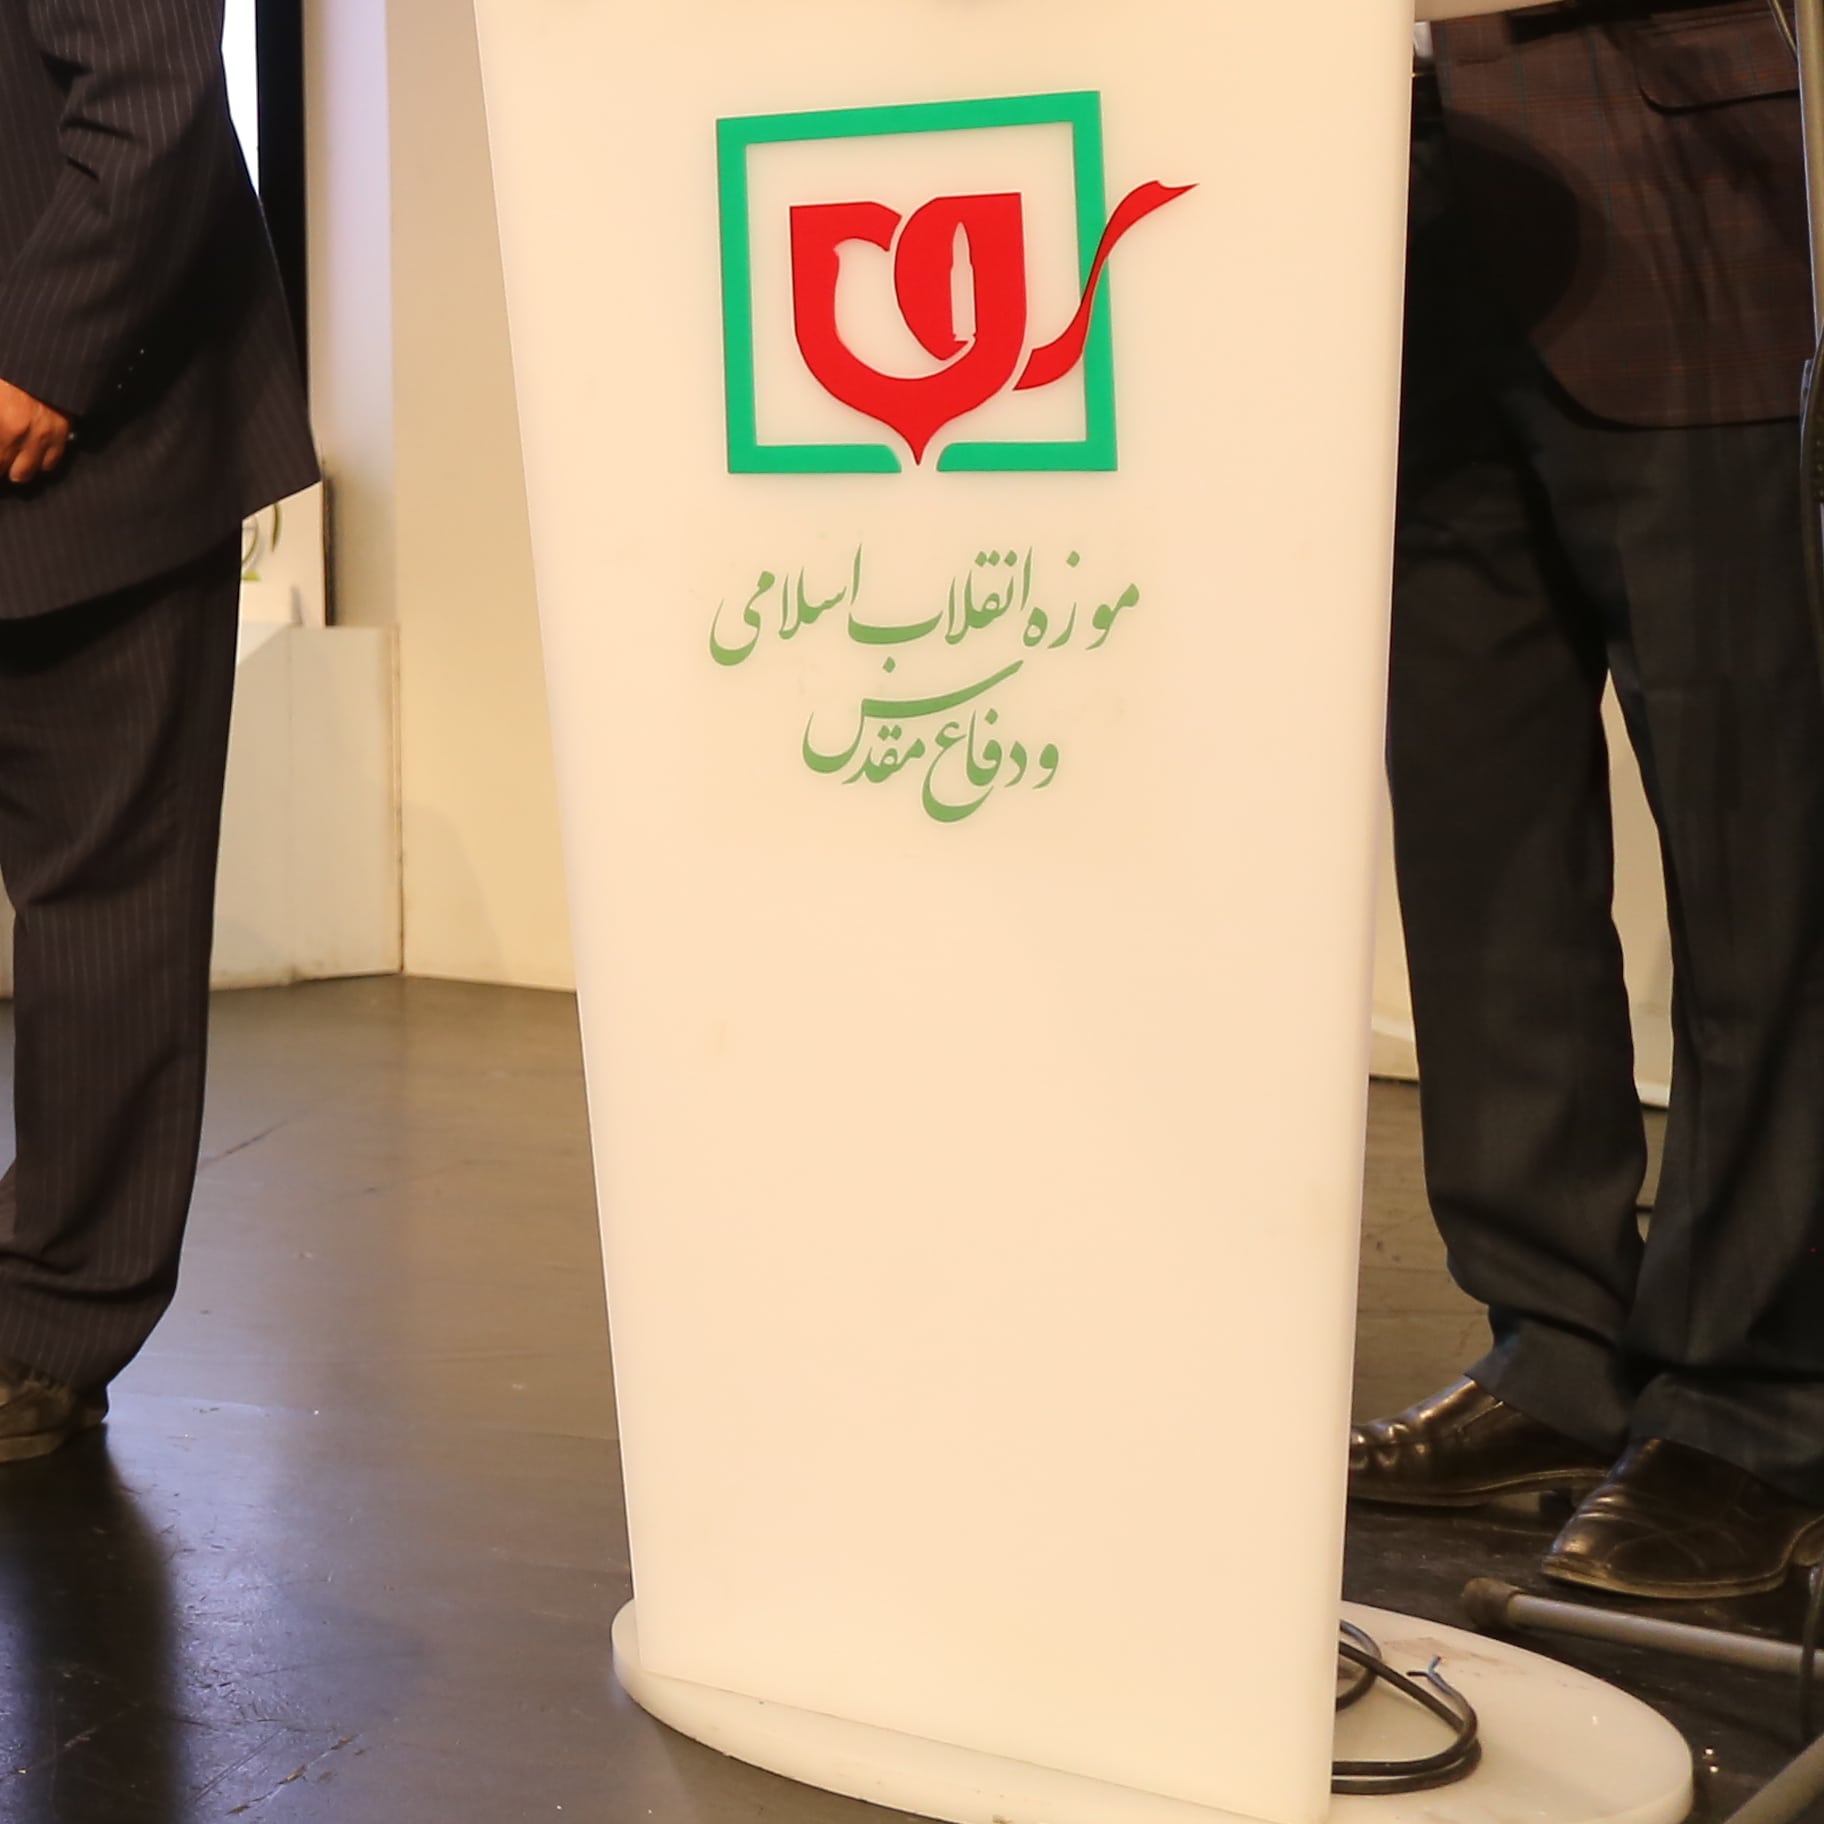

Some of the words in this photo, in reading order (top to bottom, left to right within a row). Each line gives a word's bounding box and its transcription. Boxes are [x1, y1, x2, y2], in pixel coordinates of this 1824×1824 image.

[709, 542, 863, 668] اسلامی
[847, 546, 1034, 674] انقلاب
[1021, 550, 1141, 651] موزه
[802, 659, 1024, 785] مقدس
[921, 708, 1031, 824] دفاع
[1033, 742, 1062, 790] و
